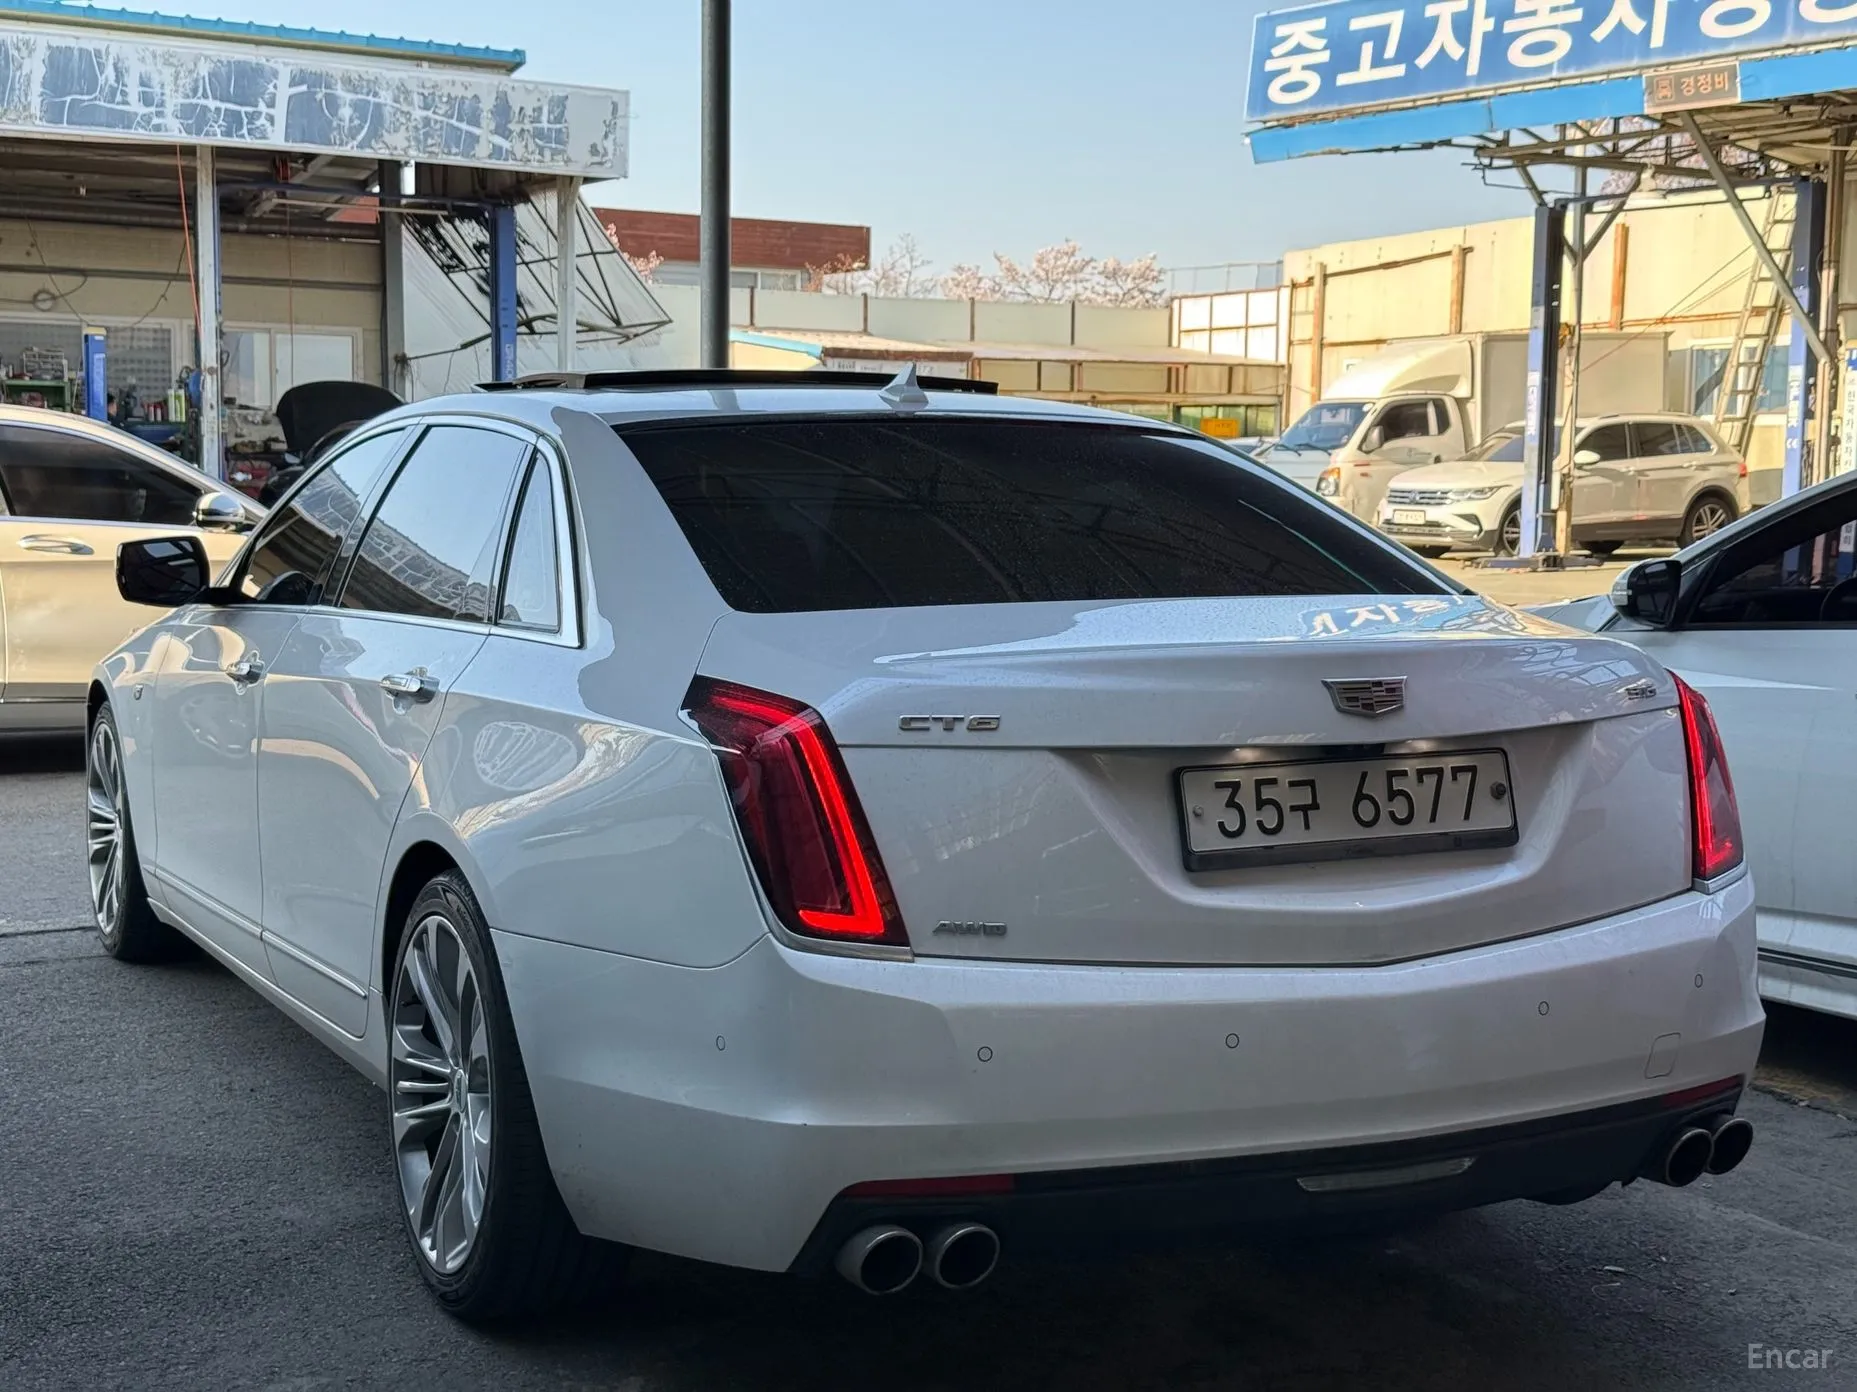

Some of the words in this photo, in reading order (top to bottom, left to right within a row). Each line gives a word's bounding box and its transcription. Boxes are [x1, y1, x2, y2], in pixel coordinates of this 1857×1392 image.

[1680, 72, 1729, 96] 경정비
[898, 713, 1001, 731] CT6
[1213, 777, 1321, 839] 35구
[1351, 764, 1478, 829] 6577
[932, 920, 1007, 937] AWD
